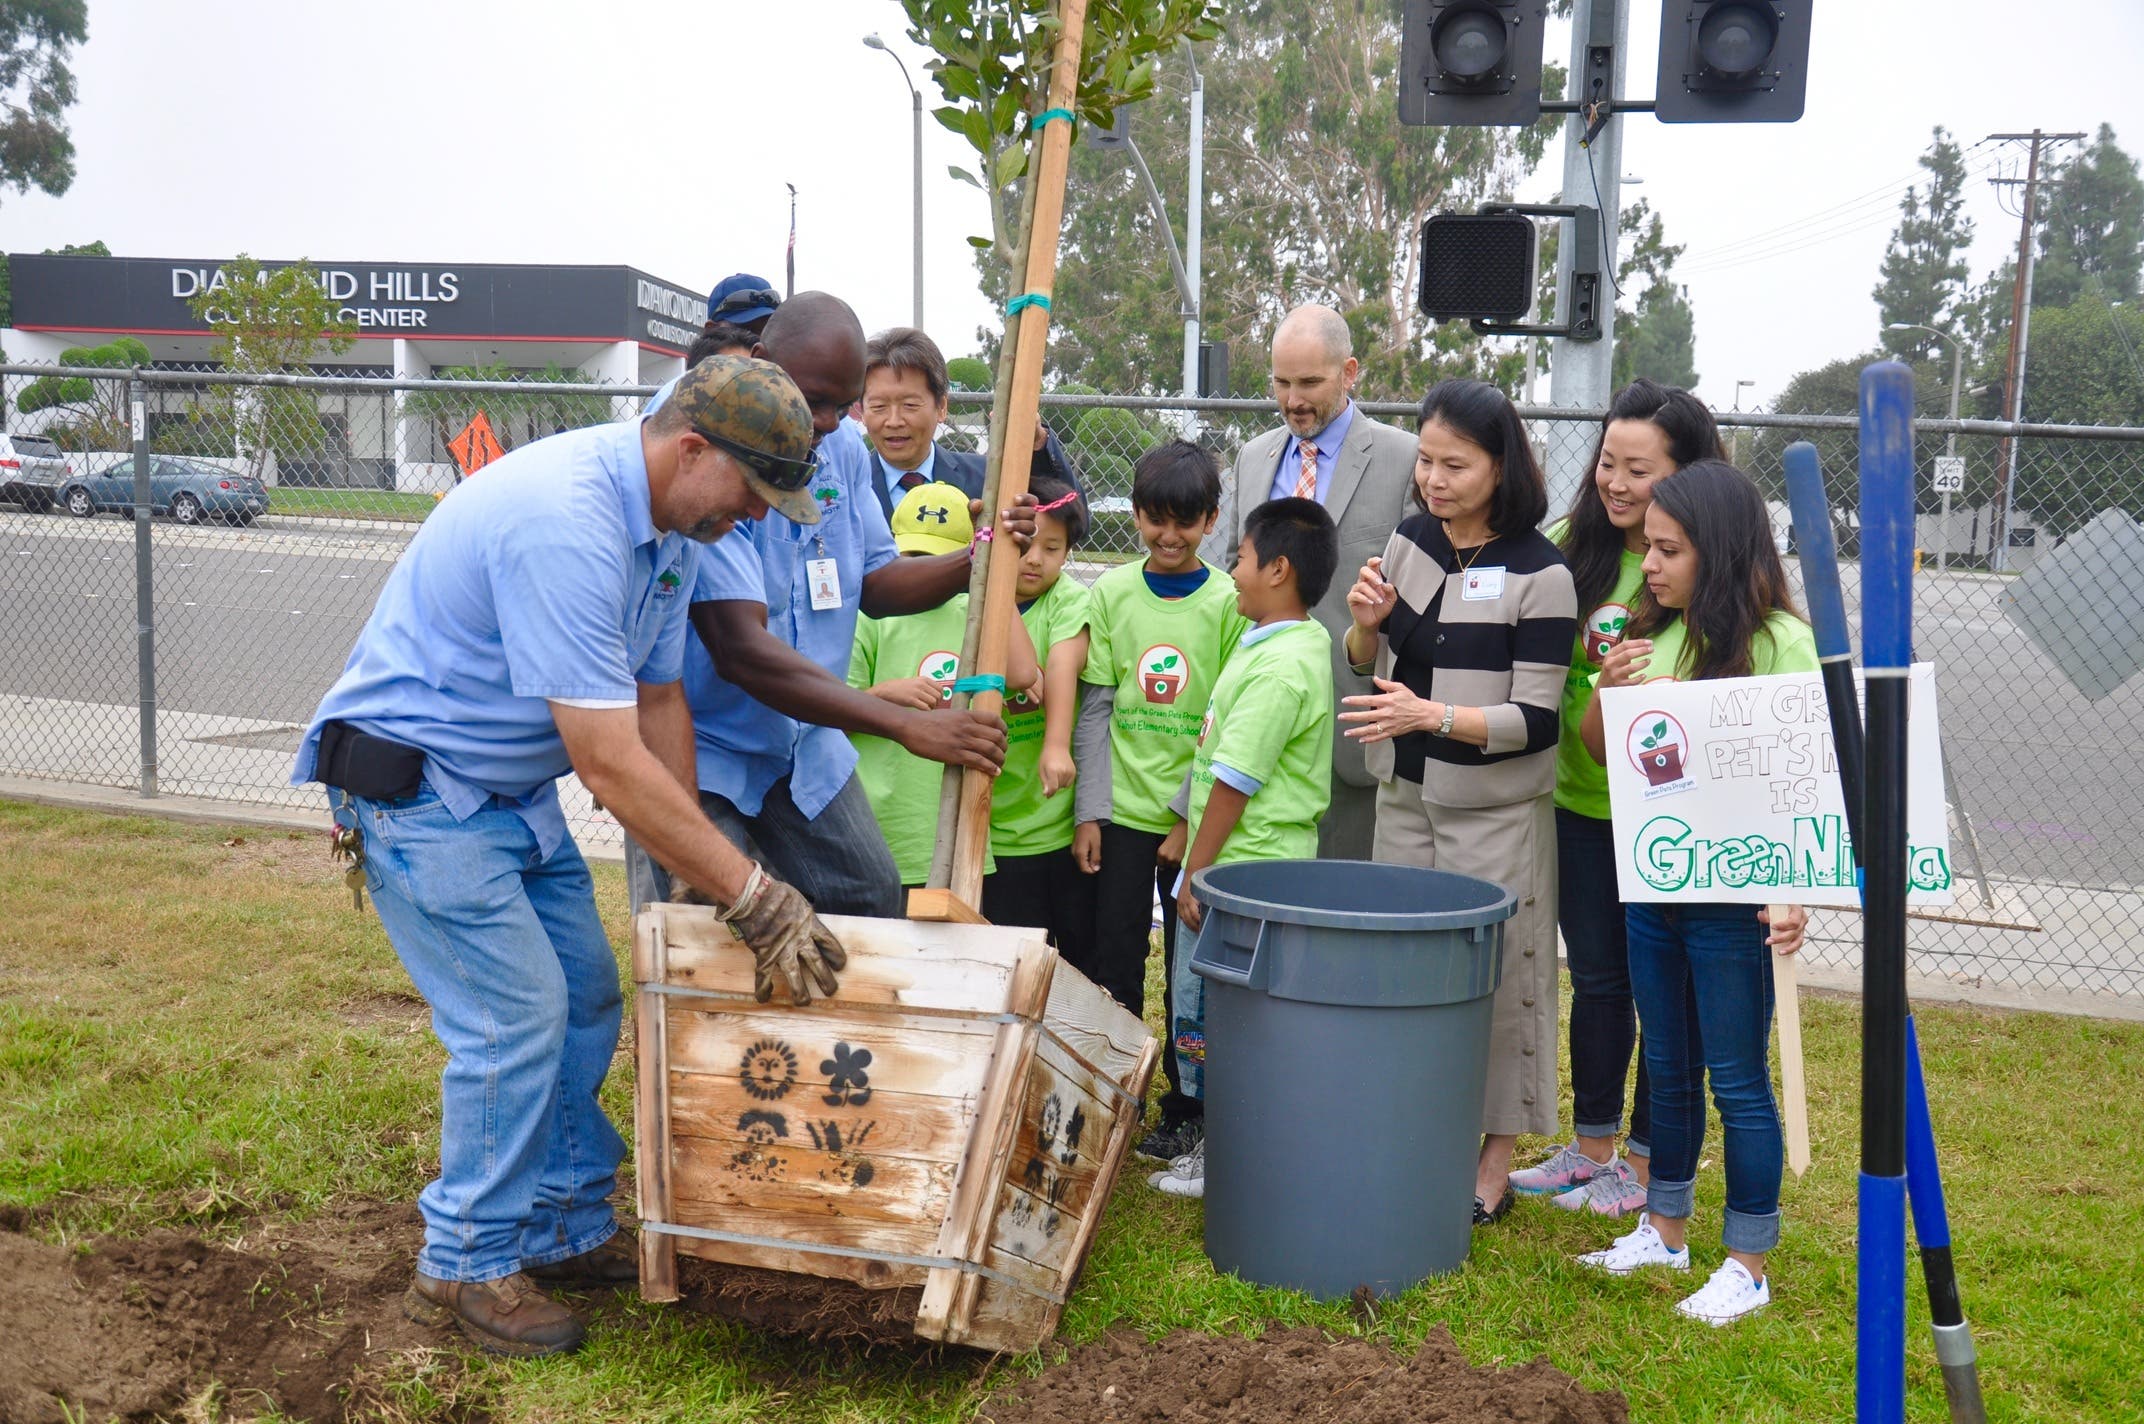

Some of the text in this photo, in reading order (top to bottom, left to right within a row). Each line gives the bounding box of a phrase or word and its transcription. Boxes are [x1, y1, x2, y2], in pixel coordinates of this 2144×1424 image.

[369, 271, 461, 303] HILLS
[336, 307, 428, 328] CENTER
[1937, 476, 1960, 488] 40
[1710, 687, 1762, 728] MY
[1138, 720, 1178, 737] Elementary
[1704, 728, 1814, 780] PET'S
[1769, 777, 1819, 815] IS
